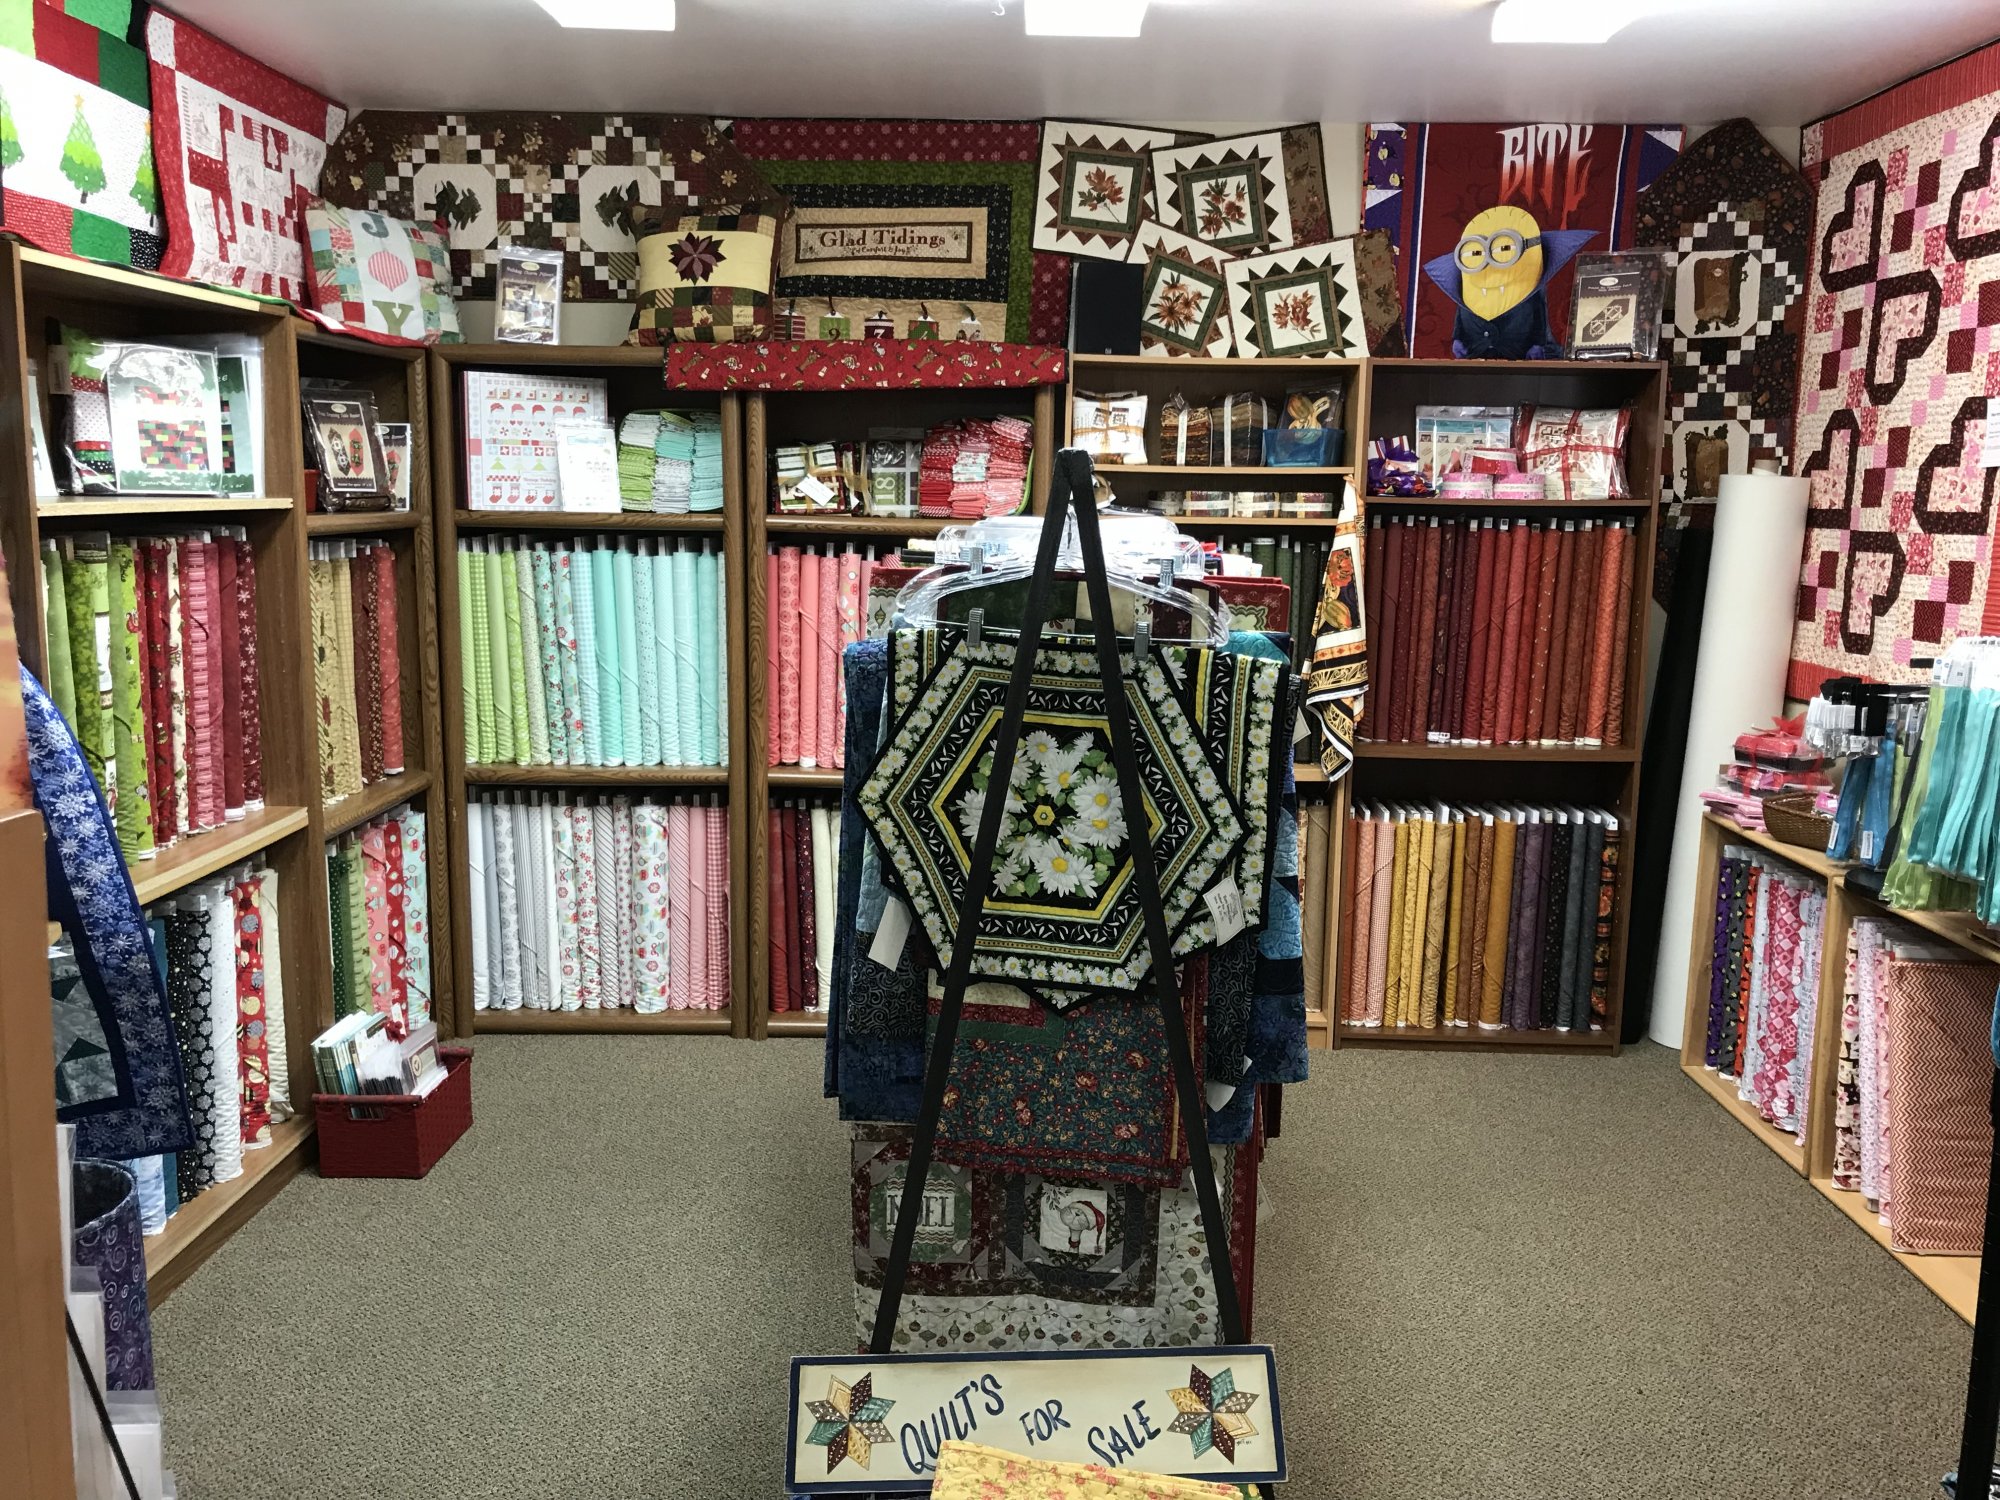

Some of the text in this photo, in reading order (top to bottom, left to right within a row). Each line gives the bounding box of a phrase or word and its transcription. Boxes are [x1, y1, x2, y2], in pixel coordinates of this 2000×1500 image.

[1496, 123, 1594, 230] BITE
[820, 228, 946, 248] Glad Tidings
[875, 476, 896, 503] 18
[887, 1194, 955, 1227] NEL
[900, 1373, 1162, 1475] QUILT'S FOR SALE
